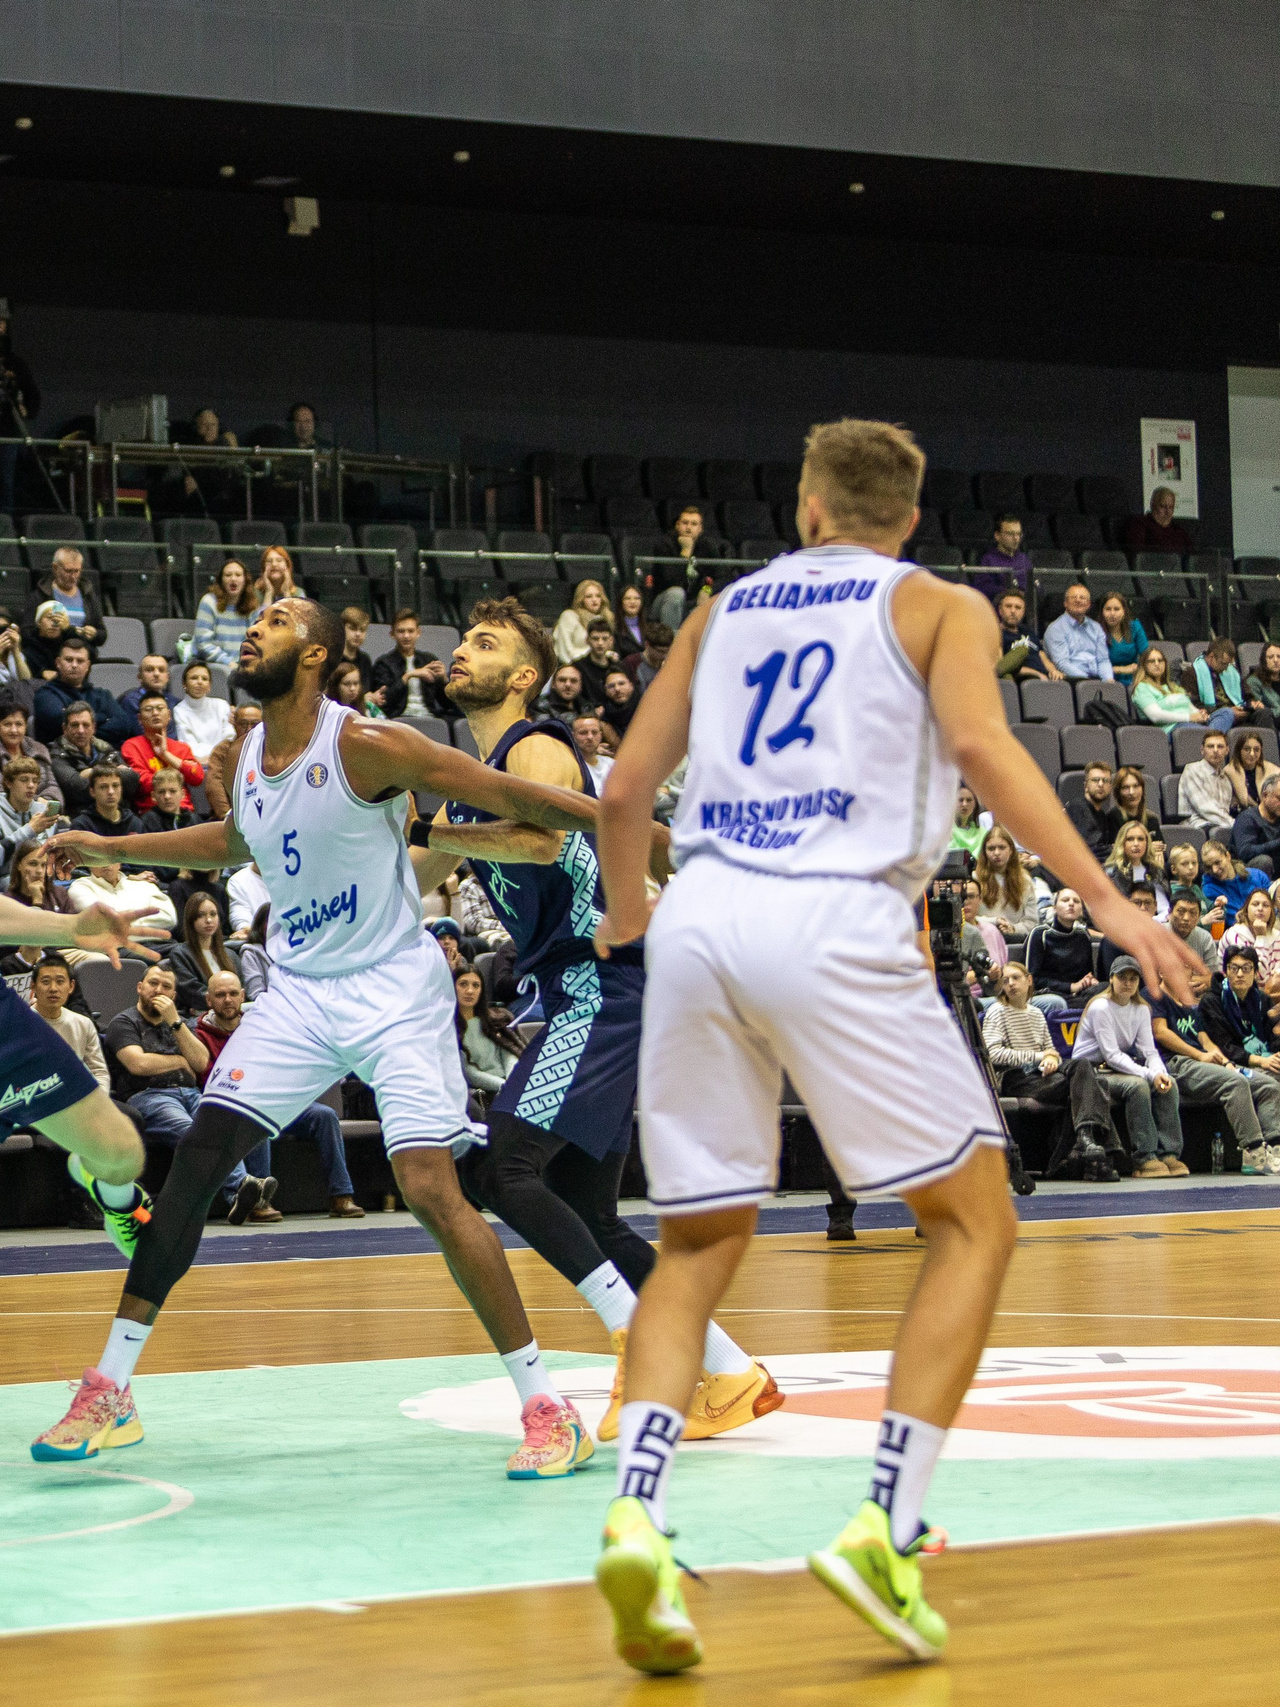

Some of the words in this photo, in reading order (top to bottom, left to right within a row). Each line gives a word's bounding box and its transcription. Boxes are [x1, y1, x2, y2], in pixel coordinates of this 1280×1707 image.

[725, 578, 879, 612] BELIANKOU
[739, 639, 834, 767] 12
[282, 829, 301, 876] 5
[281, 884, 357, 948] Enisey
